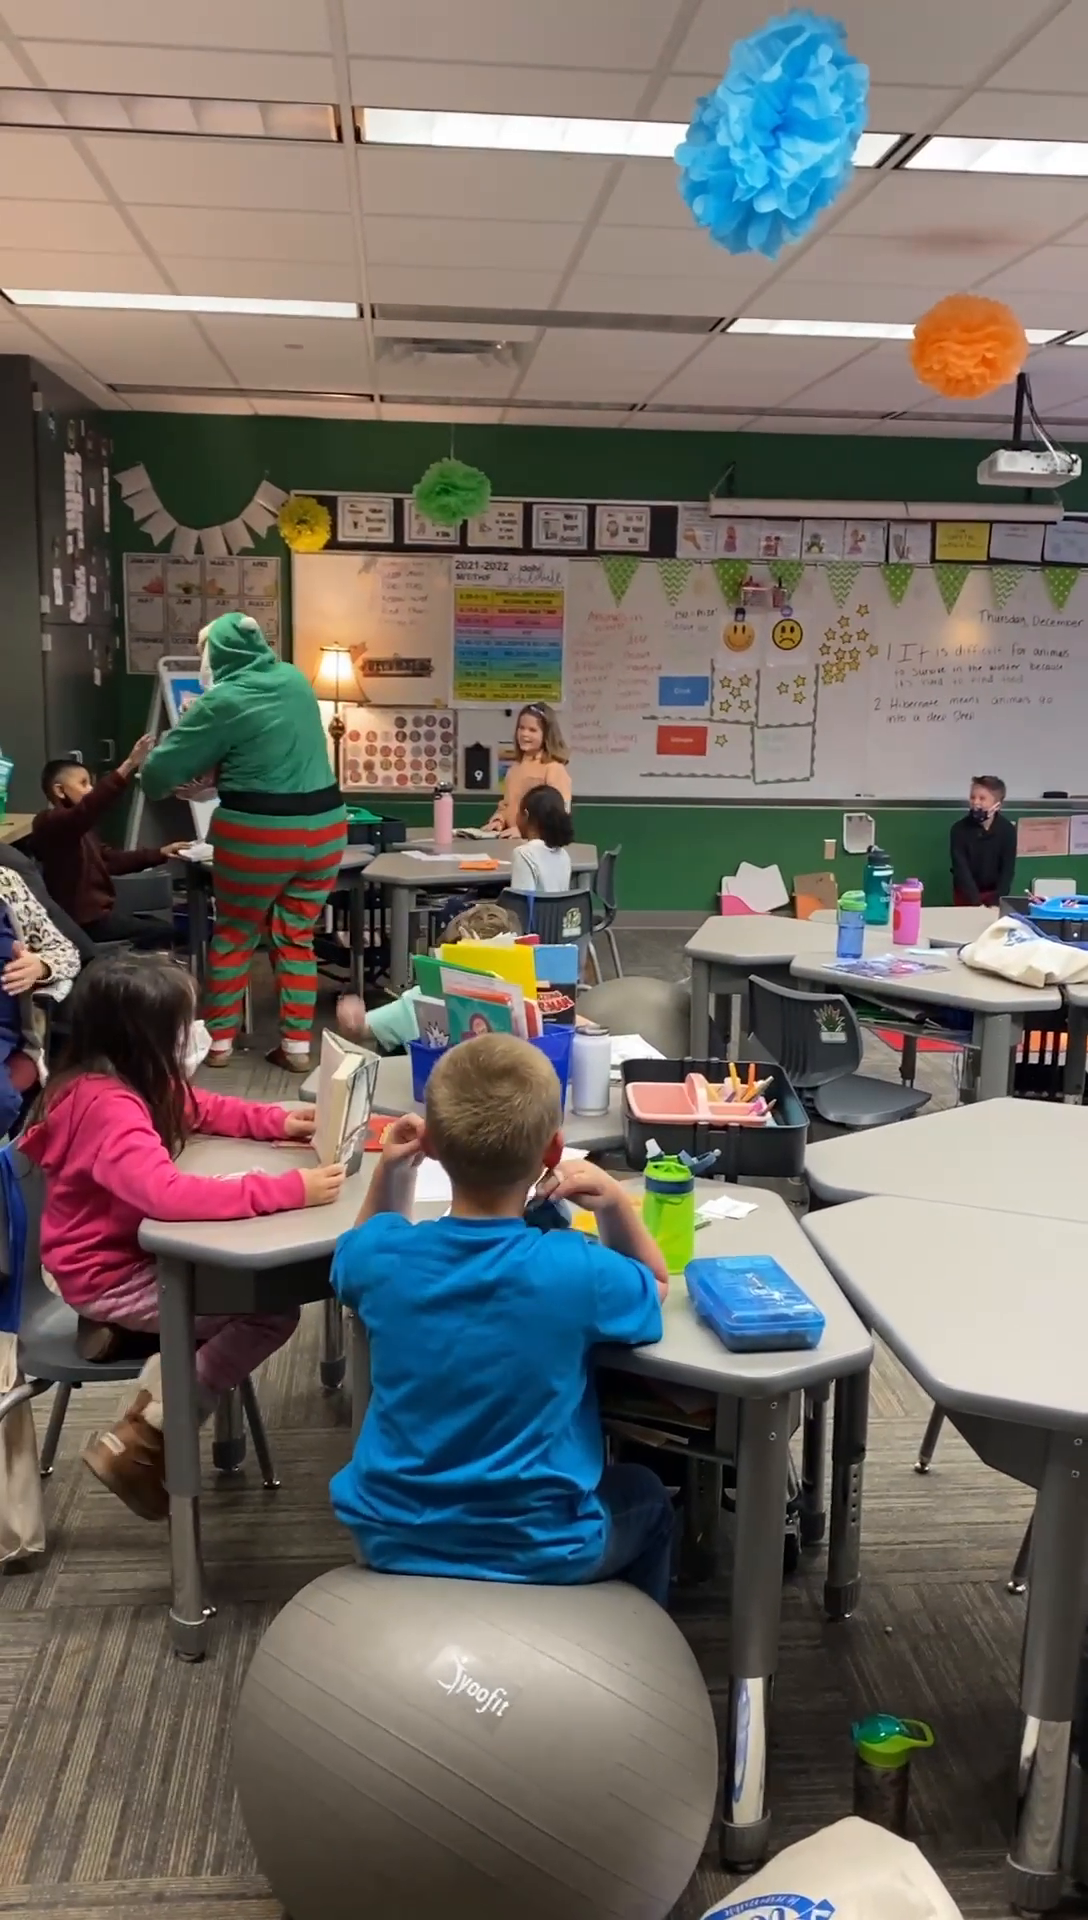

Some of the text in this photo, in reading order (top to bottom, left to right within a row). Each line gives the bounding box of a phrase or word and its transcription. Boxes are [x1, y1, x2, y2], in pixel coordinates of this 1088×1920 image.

[455, 560, 509, 571] 2021-2022
[1032, 616, 1084, 628] December
[1011, 643, 1027, 657] for
[474, 770, 484, 781] 9
